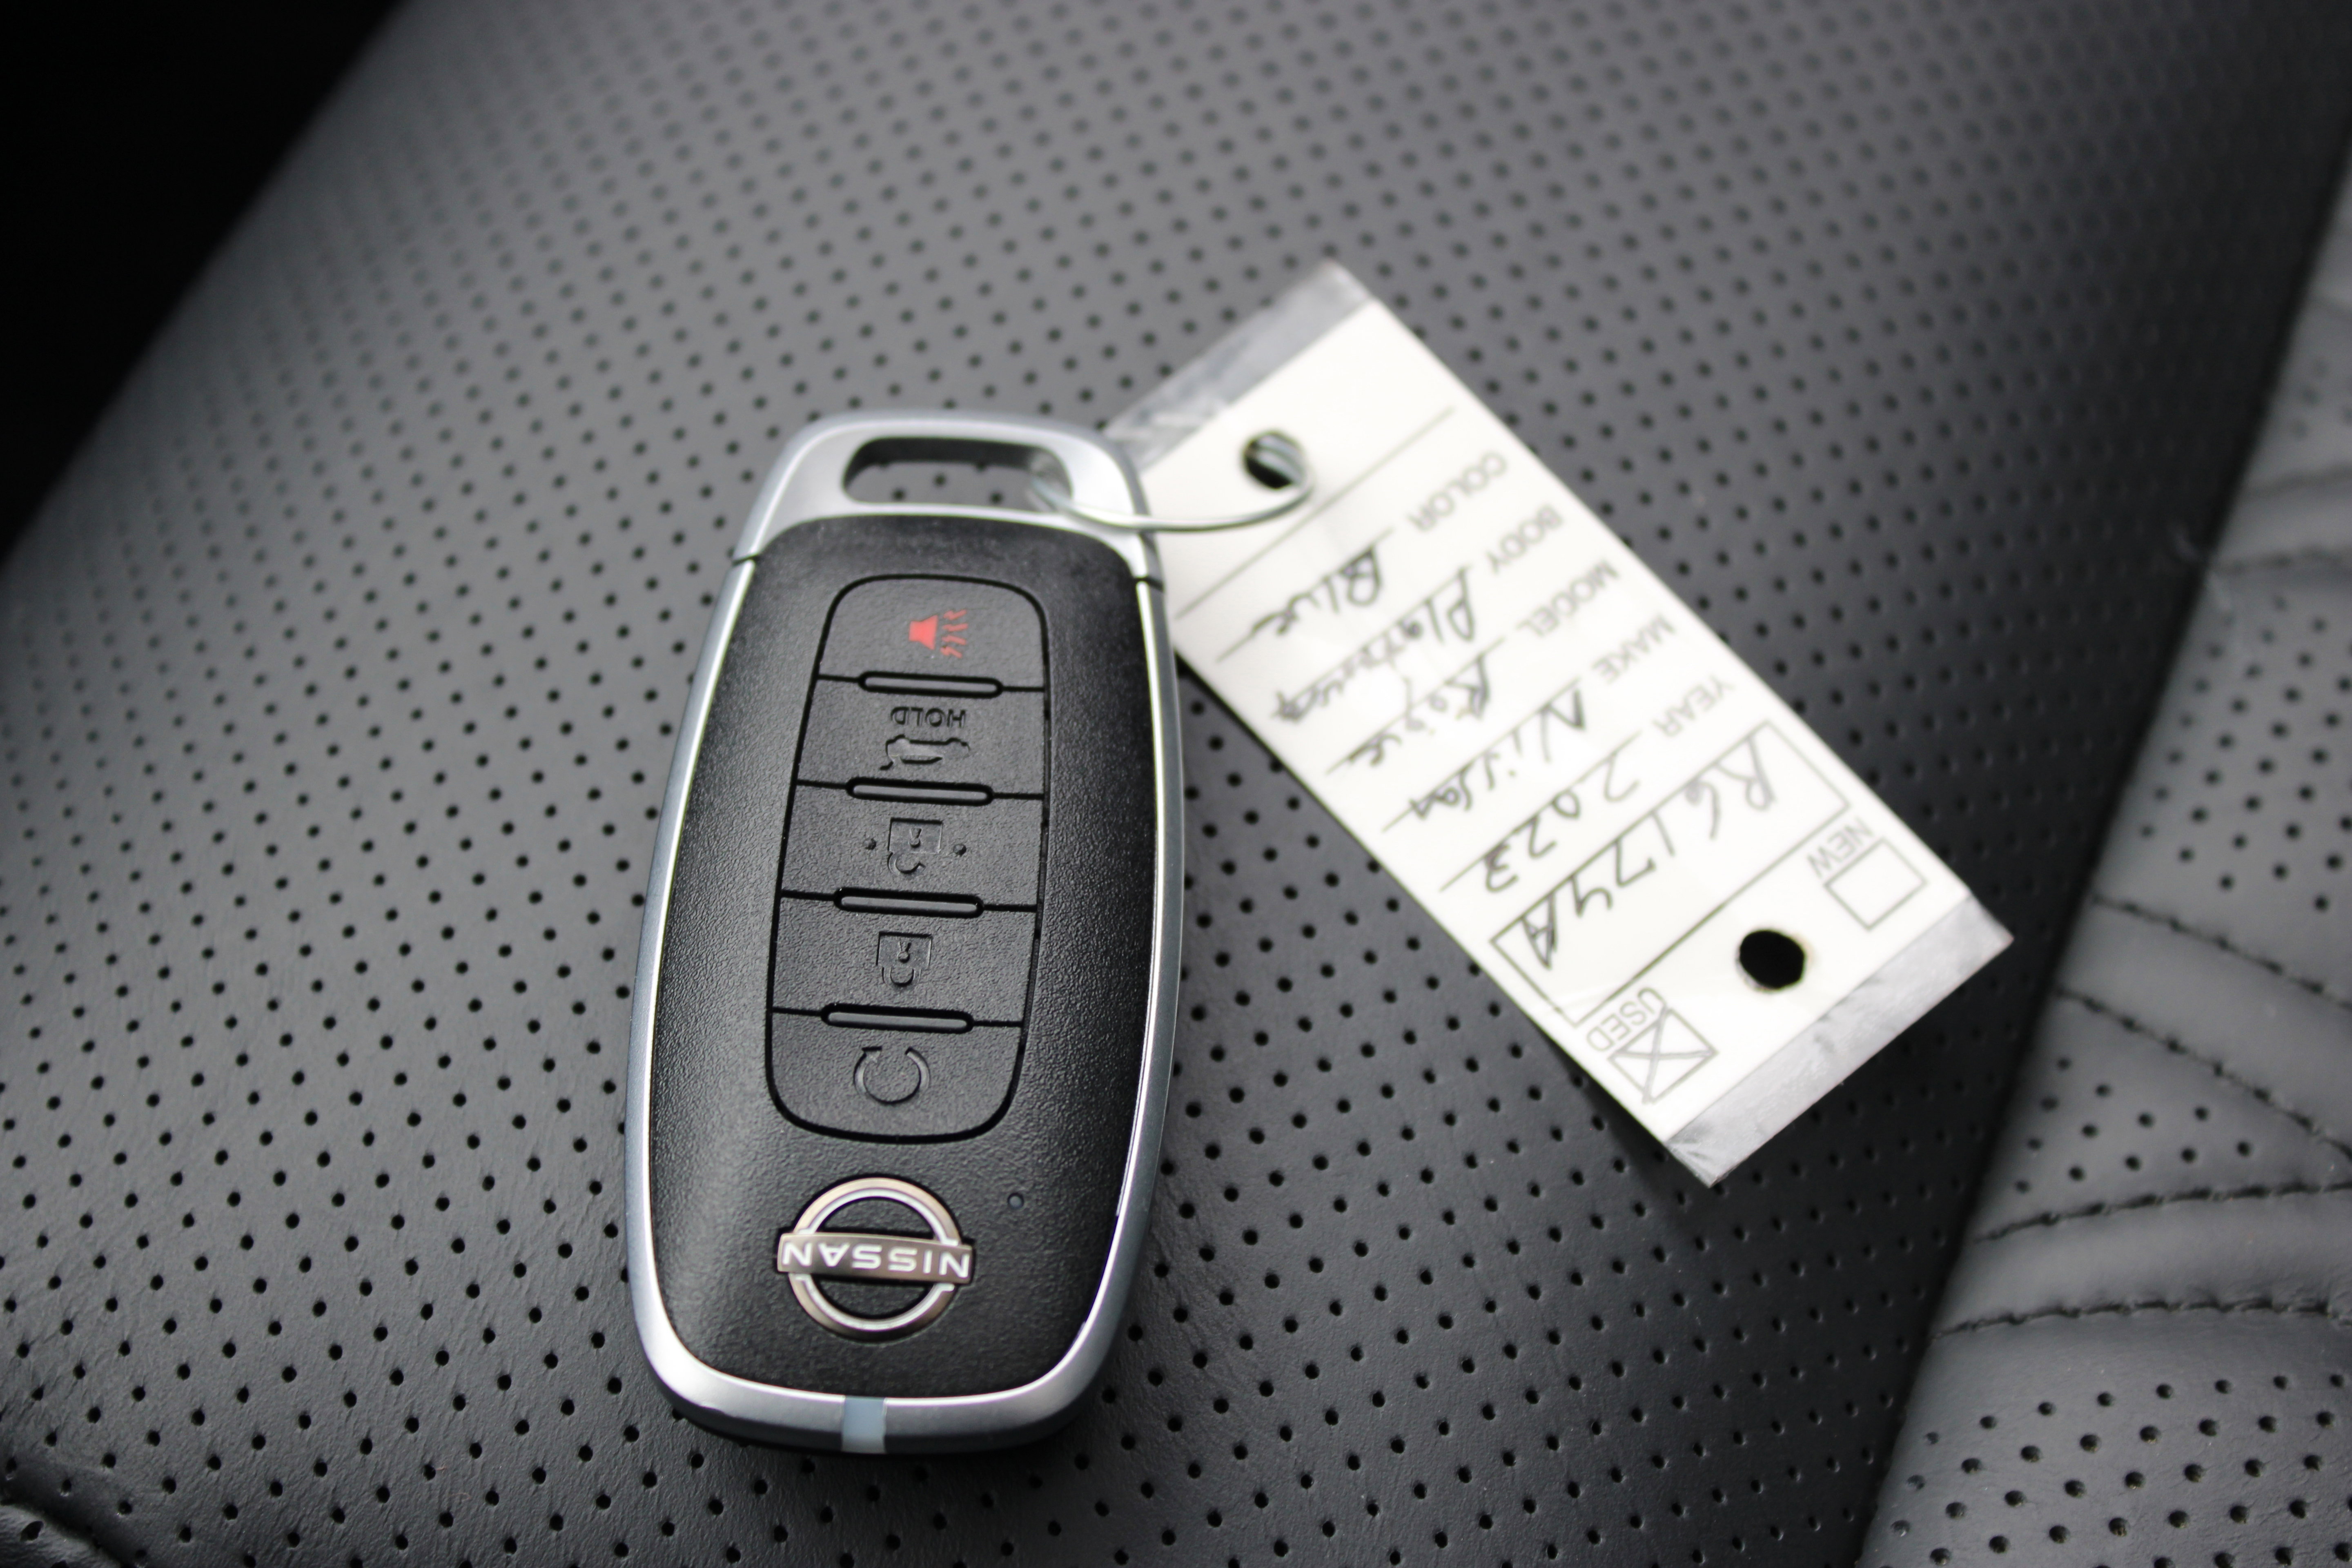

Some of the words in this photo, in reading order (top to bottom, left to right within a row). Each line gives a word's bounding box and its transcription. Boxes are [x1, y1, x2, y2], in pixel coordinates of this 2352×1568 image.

[1408, 452, 1507, 531] COLOR
[1486, 506, 1563, 572] BODY
[1251, 546, 1381, 637] Blue
[1517, 559, 1620, 637] MODEL
[1592, 615, 1676, 684] MAKE
[890, 706, 967, 728] HOLD
[1652, 676, 1735, 737] YEAR
[1484, 753, 1639, 892] 2023
[1522, 736, 1775, 970] R6174A
[1806, 818, 1873, 878] NEW
[1586, 987, 1666, 1053] USED
[782, 1241, 970, 1278] NISSAN
